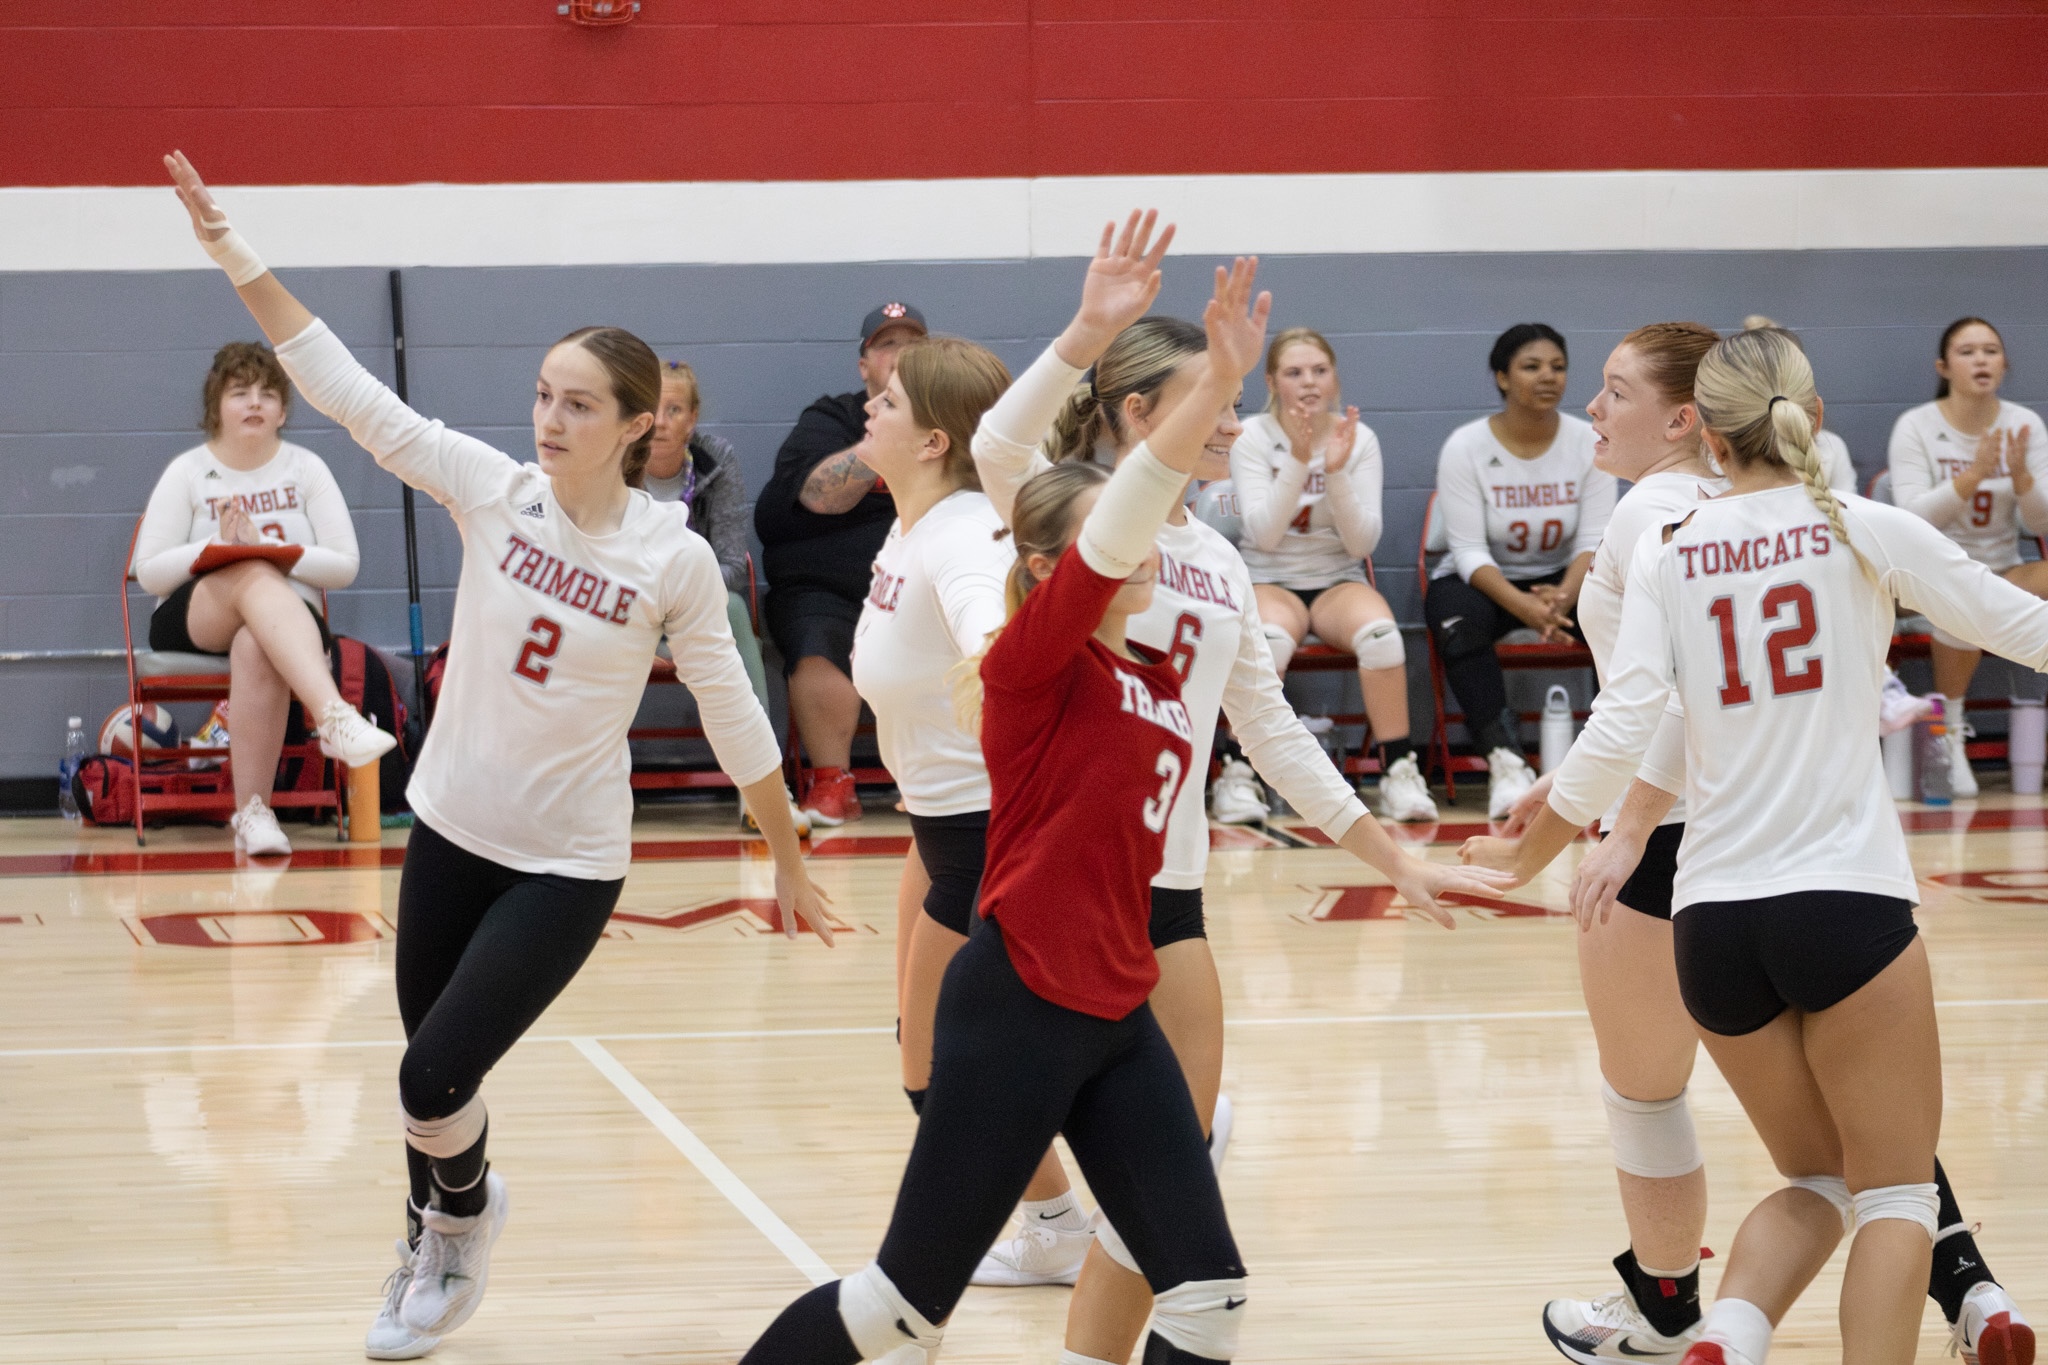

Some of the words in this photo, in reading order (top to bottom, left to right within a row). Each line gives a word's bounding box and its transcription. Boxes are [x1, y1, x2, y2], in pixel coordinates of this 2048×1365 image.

[205, 486, 298, 521] TMBLE
[1492, 482, 1578, 508] TRIMBLE
[1972, 490, 1993, 528] 9
[1506, 519, 1563, 554] 30
[1679, 523, 1831, 580] TOMCATS
[500, 532, 639, 627] TRIMBLE
[511, 614, 566, 688] 2
[1168, 610, 1204, 687] 6
[1707, 580, 1824, 709] 12
[1143, 749, 1182, 834] 3
